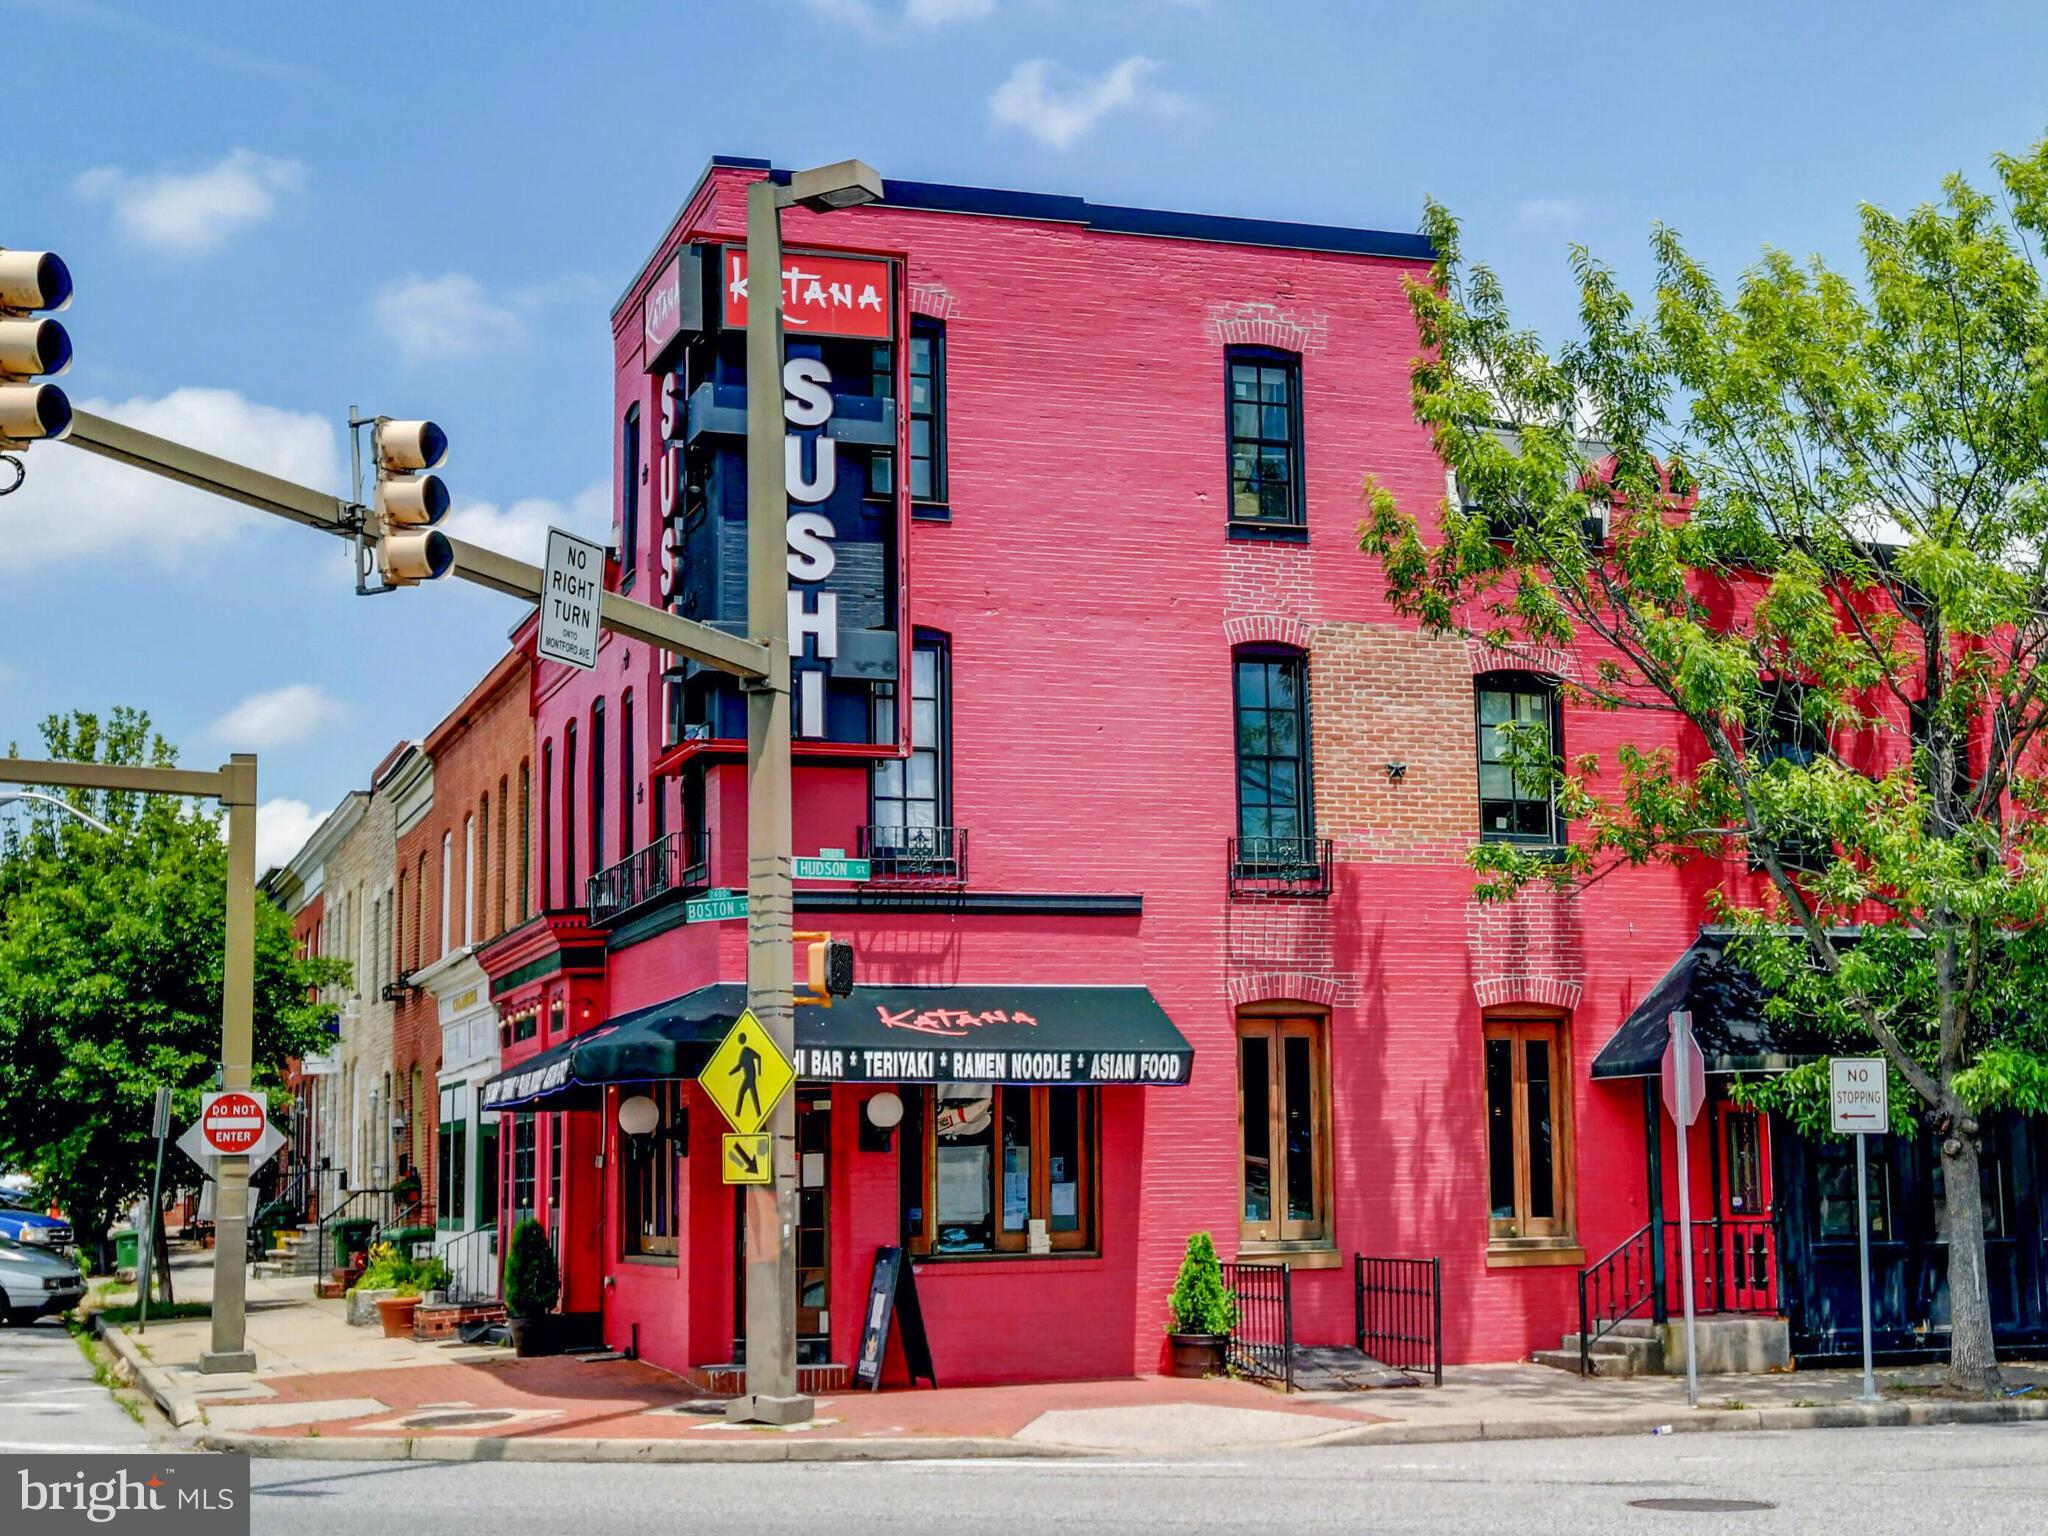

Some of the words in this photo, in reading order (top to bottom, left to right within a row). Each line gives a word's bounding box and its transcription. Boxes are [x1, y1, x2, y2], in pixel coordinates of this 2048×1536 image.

[730, 256, 882, 324] KTANA
[783, 358, 838, 737] SUSHI
[567, 546, 586, 570] NO
[552, 570, 594, 601] RIGHT
[554, 599, 590, 629] TURN
[562, 628, 578, 641] ONTO
[545, 636, 578, 655] MONTFORD
[800, 861, 847, 876] HUDSON
[688, 901, 734, 919] BOSTON
[811, 1050, 843, 1077] BAR
[863, 1051, 934, 1078] TERIYAKI
[953, 1053, 1006, 1079] RAMEN
[1011, 1053, 1071, 1080] NOODLE
[1090, 1053, 1136, 1080] ASIAN
[1140, 1054, 1180, 1080] FOOD
[1847, 1069, 1868, 1082] NO
[1837, 1090, 1880, 1104] STOPPING
[212, 1105, 228, 1115] DO
[233, 1104, 256, 1115] NOT
[216, 1131, 251, 1142] ENTER
